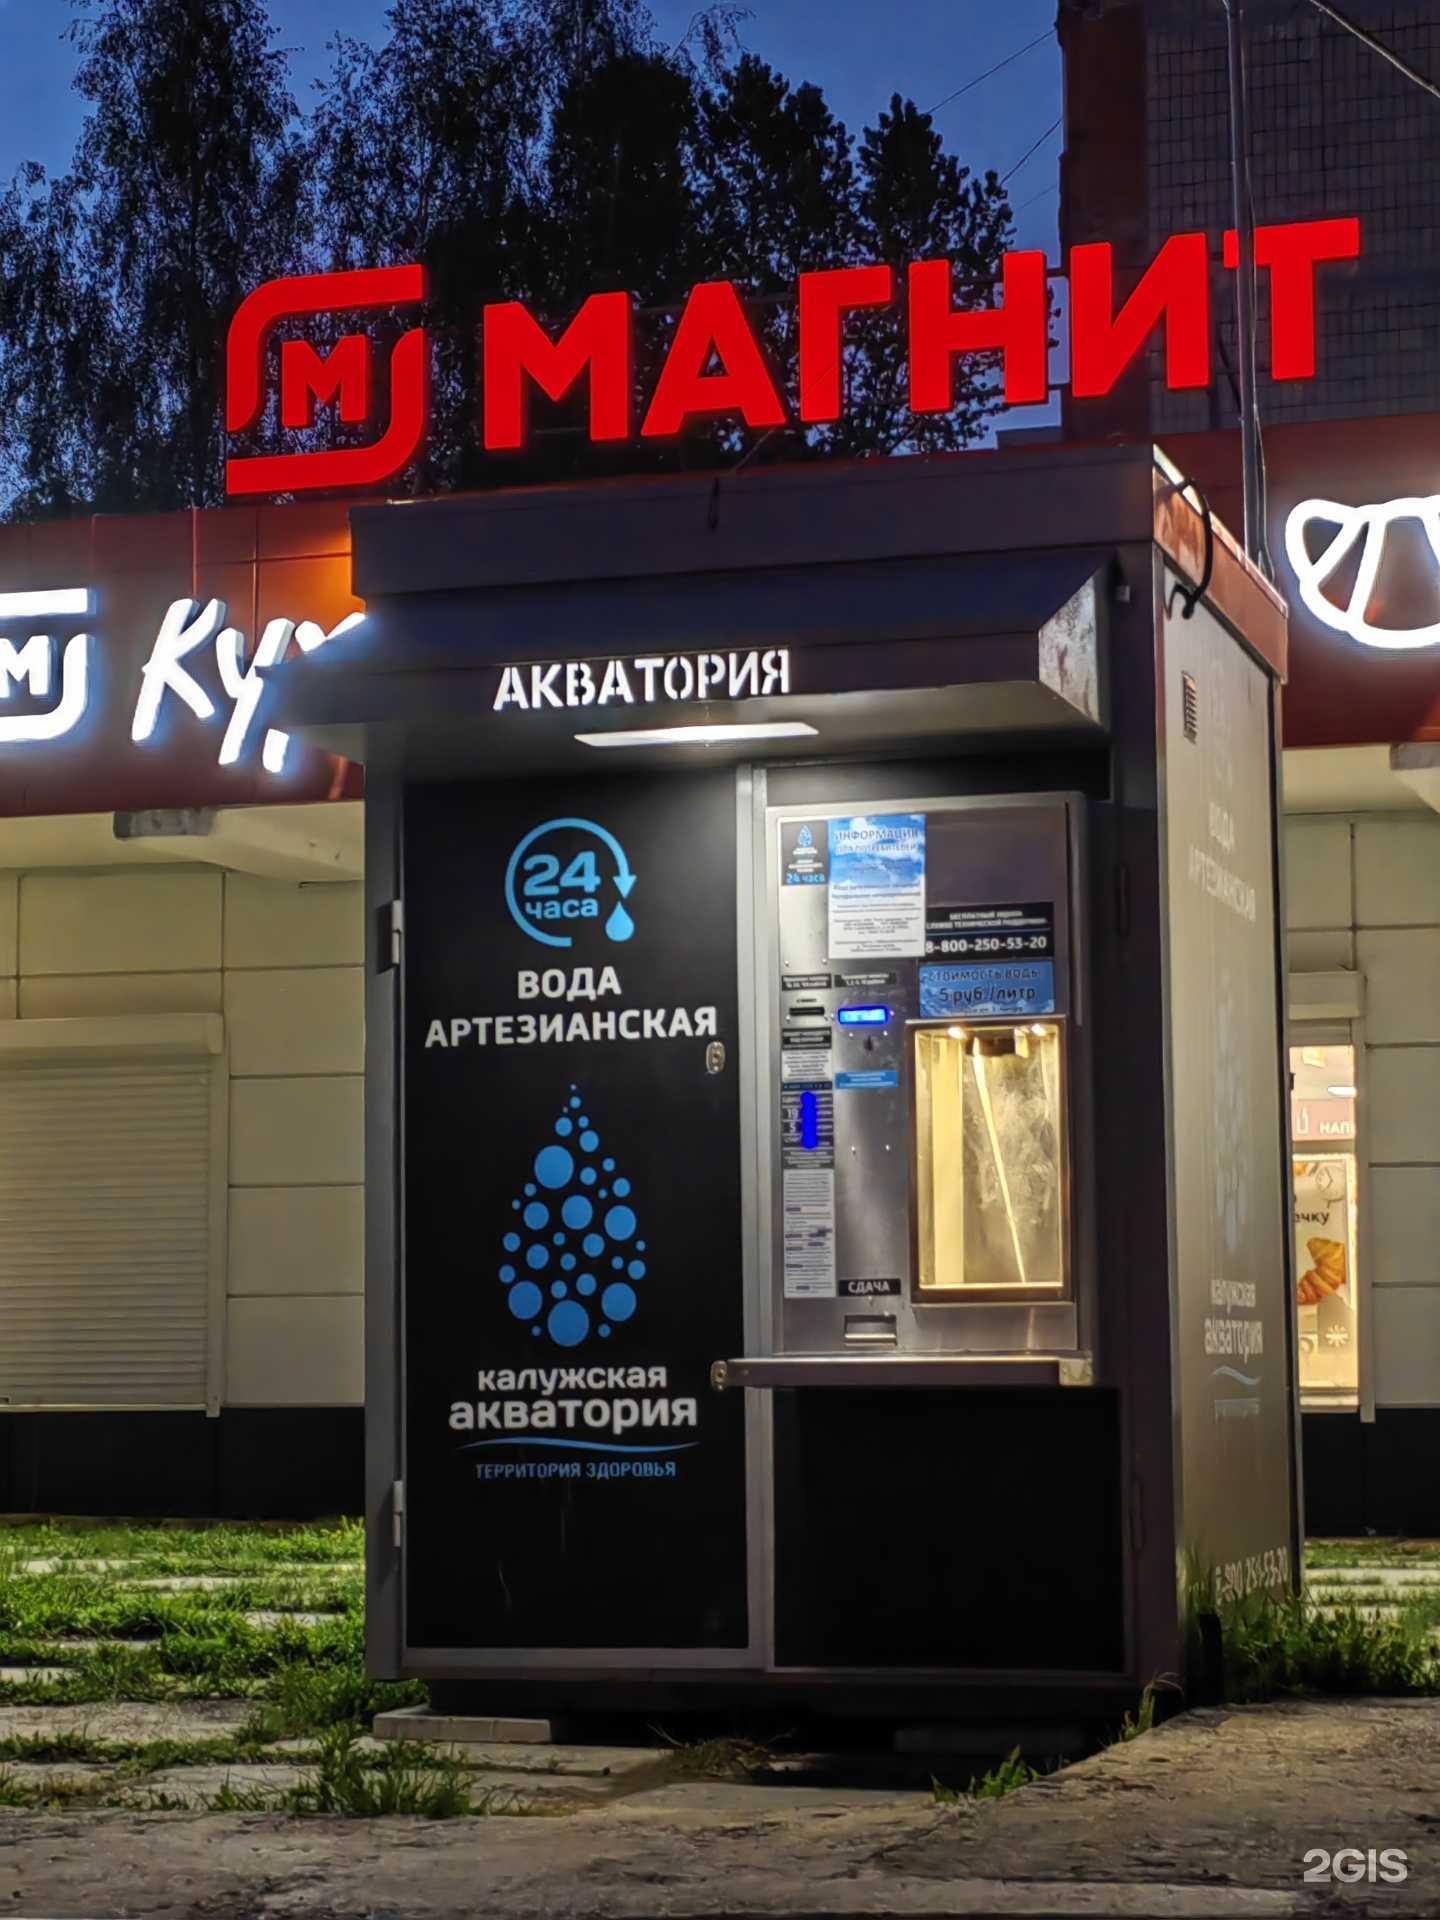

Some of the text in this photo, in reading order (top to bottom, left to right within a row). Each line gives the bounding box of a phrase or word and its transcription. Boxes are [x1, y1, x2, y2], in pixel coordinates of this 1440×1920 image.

[482, 217, 1361, 450] МАГНИТ
[493, 647, 792, 712] АКВАТОРИЯ
[523, 850, 602, 897] 24
[524, 898, 600, 920] часа
[925, 936, 1048, 954] 8-800-250-53-20
[517, 965, 623, 1002] ВОДА
[938, 987, 949, 1002] 5
[424, 1005, 718, 1049] АРТЕЗИАНСКАЯ
[847, 1280, 891, 1294] СДАЧА
[477, 1365, 668, 1396] калужская
[448, 1397, 698, 1436] акватория
[475, 1460, 677, 1480] ТЕРРИТОРИЯ ЗДОРОВЬЯ
